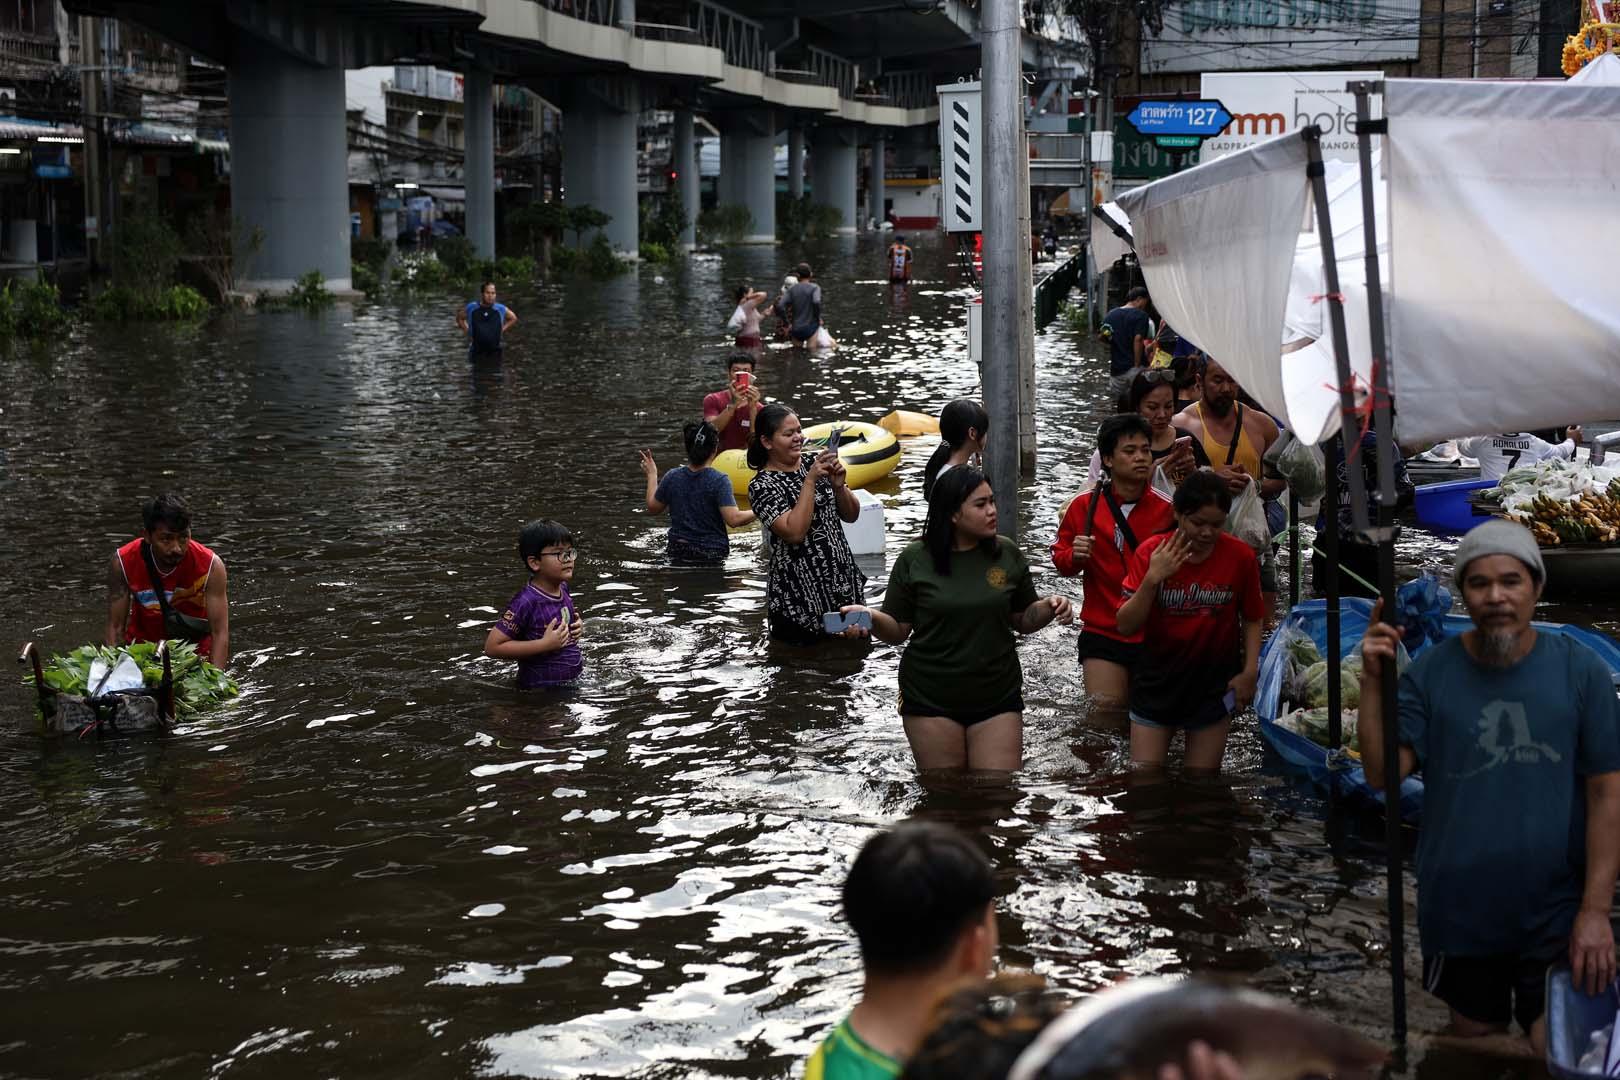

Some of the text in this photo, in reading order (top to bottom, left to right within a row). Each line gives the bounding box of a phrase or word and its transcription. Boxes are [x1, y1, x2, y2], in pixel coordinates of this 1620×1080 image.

[1141, 103, 1218, 126] ลาดพร้าว 127
[1211, 142, 1257, 151] LADPRA
[1493, 440, 1530, 449] RONALDO
[1502, 449, 1521, 472] 7
